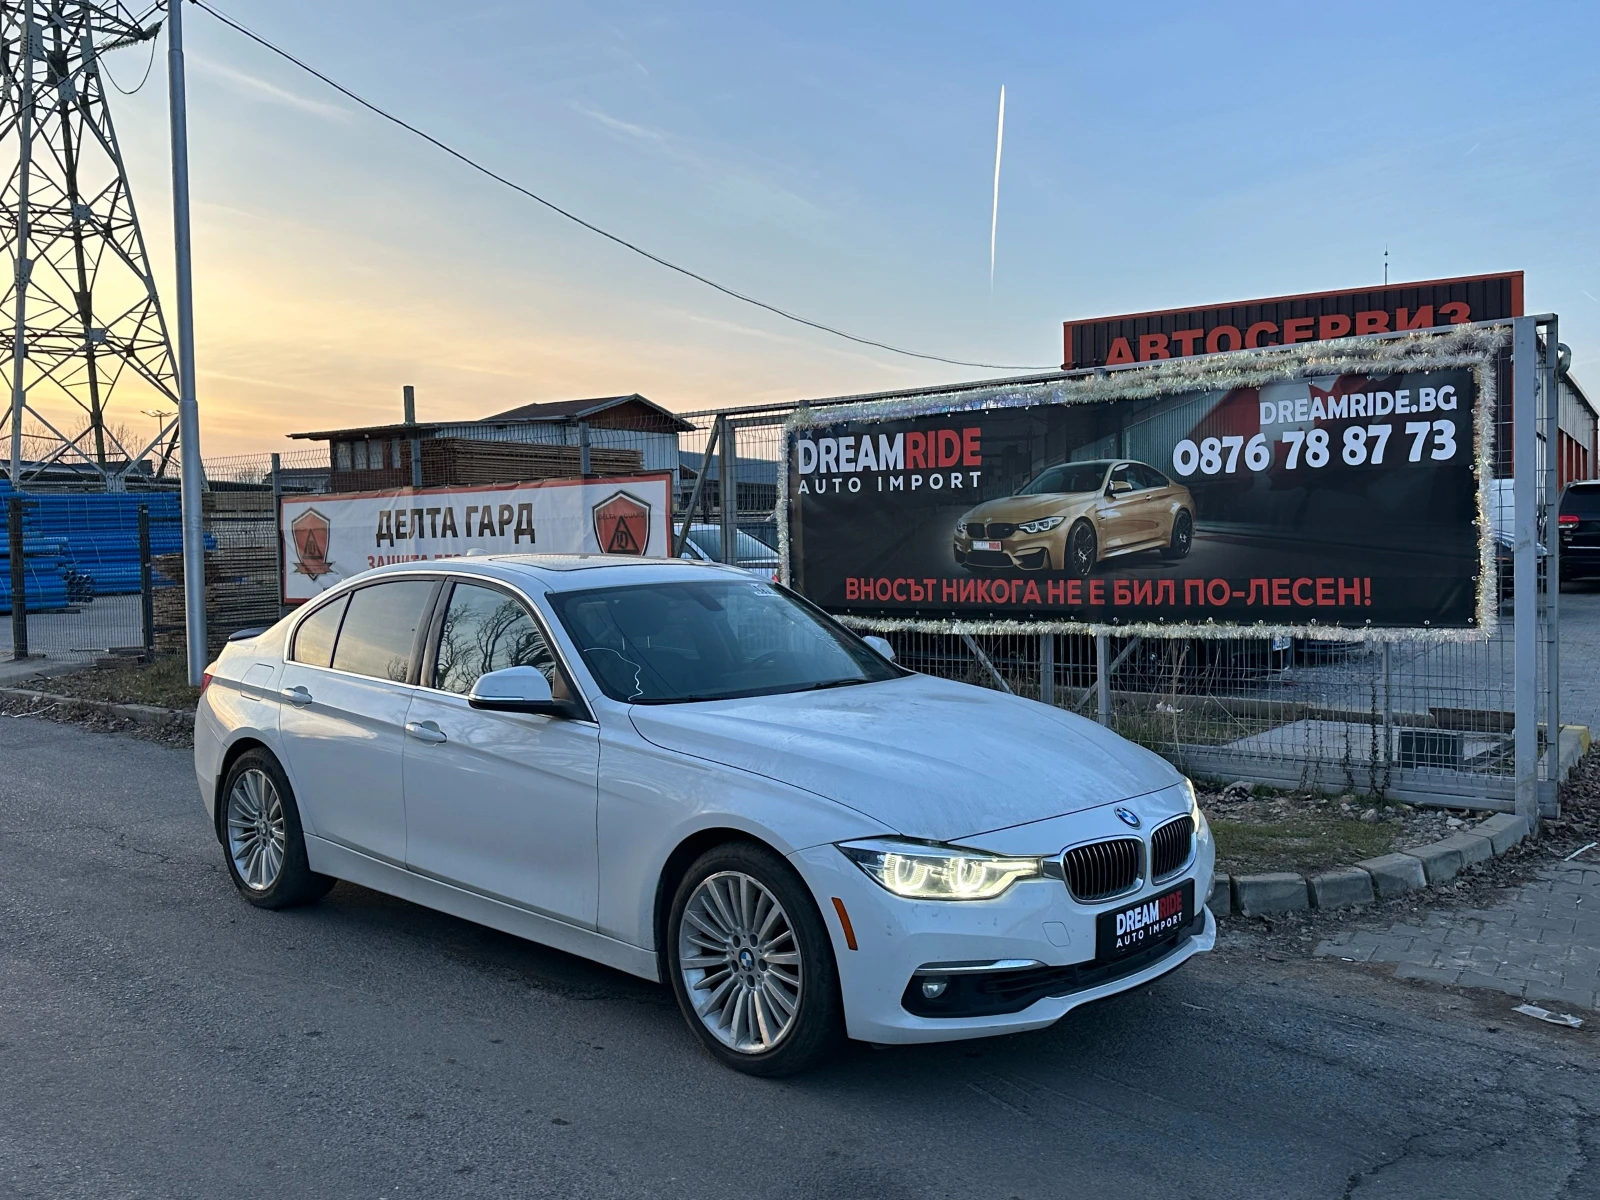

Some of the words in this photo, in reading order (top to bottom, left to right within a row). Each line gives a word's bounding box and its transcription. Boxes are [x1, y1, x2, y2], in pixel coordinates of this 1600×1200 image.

[1105, 301, 1471, 366] АВТОСЕРВИЗ
[1259, 385, 1457, 426] DREAMRIDE.BG
[798, 427, 982, 475] DREAMRIDE
[1172, 432, 1270, 476] 0876
[1281, 429, 1330, 470] 78
[1342, 424, 1392, 466] 87
[1405, 419, 1457, 463] 73
[798, 477, 862, 494] AUTO
[878, 471, 982, 491] IMPORT
[376, 507, 459, 547] ДЕЛТА
[465, 503, 536, 544] ГАРД
[845, 577, 937, 601] ВНОСЪТ
[943, 579, 1042, 604] НИКОГА
[1048, 580, 1083, 605] НЕ
[1089, 580, 1105, 605] Е
[1114, 579, 1175, 606] БИЛ
[1184, 577, 1372, 606] ПО-ЛЕСЕН!
[1116, 891, 1182, 936] DREAMRIDE
[1116, 931, 1144, 948] AUTO
[1150, 912, 1182, 935] IMPORT
